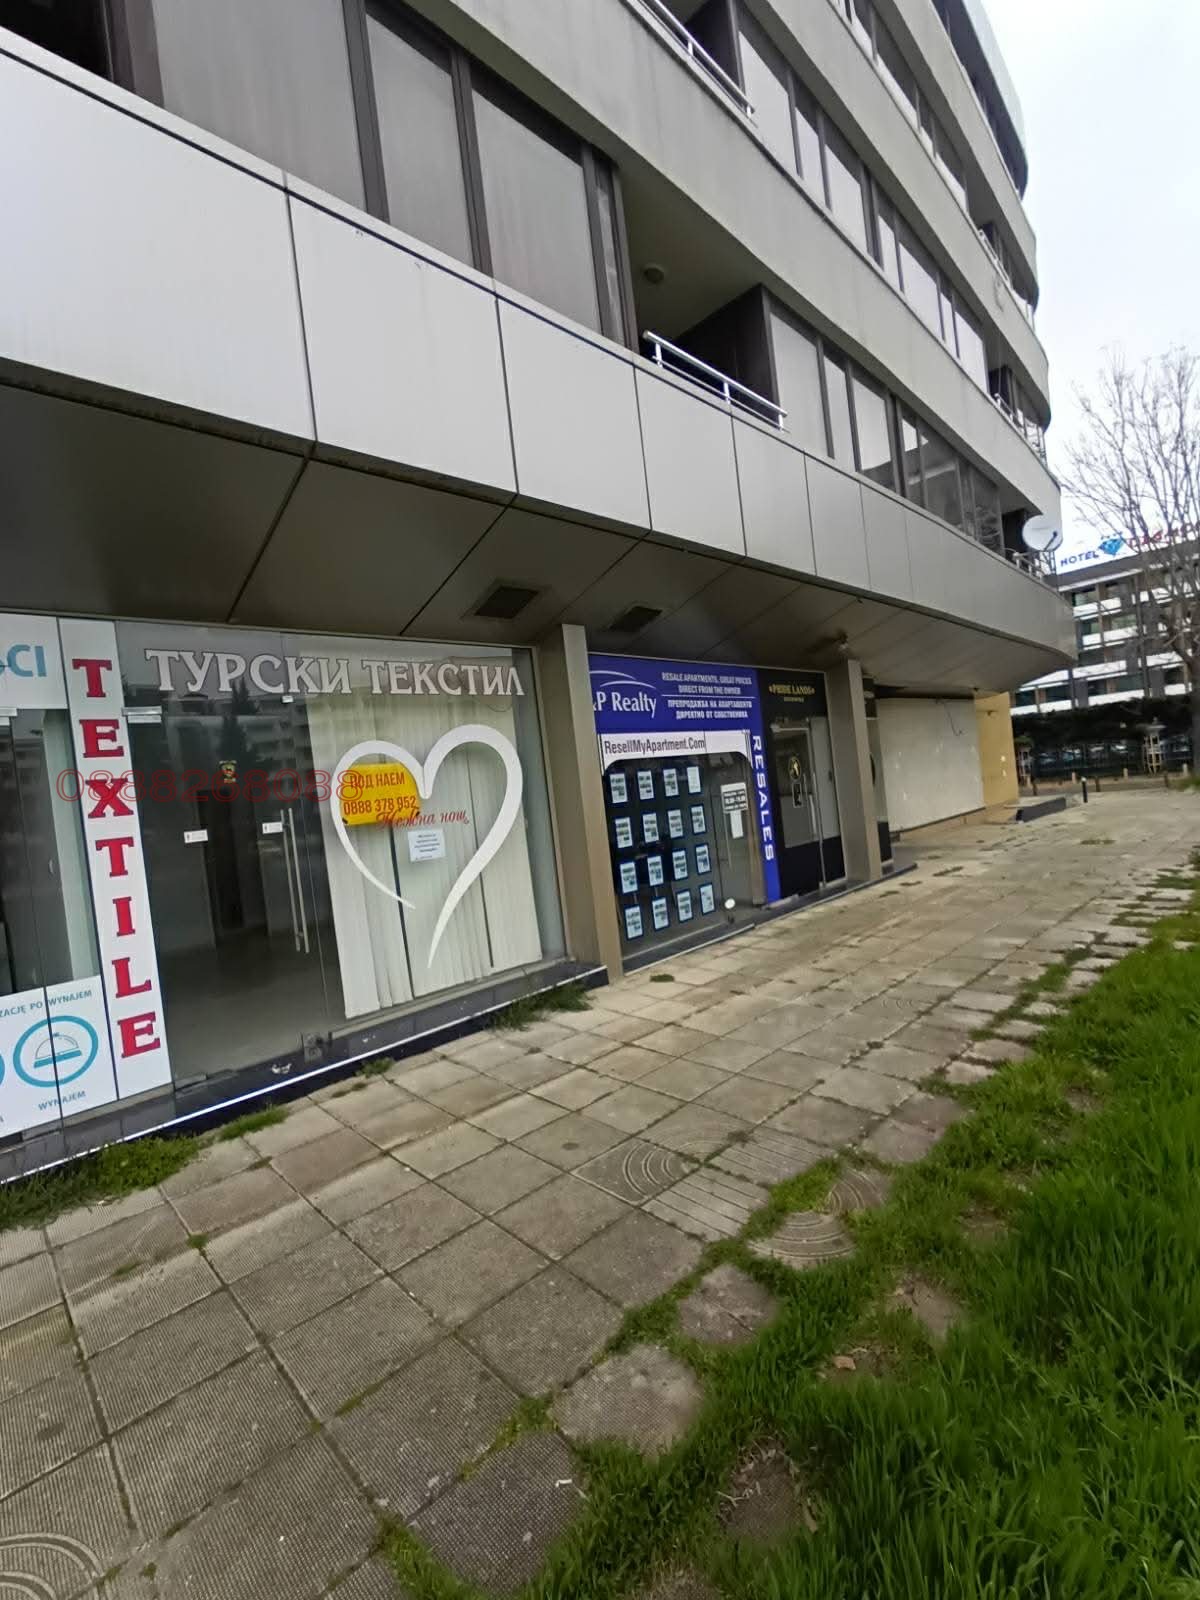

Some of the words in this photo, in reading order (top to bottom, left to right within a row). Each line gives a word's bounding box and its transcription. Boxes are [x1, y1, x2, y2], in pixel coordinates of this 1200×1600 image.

[1060, 550, 1099, 567] HOTEL
[144, 649, 352, 695] ТУРСКИ
[361, 659, 525, 696] ТЕКСТИЛ
[698, 686, 714, 694] FROM
[611, 691, 657, 719] Realty
[604, 737, 705, 755] ResellMyApartment.Com
[349, 773, 374, 789] ПОД
[376, 772, 405, 786] НАЕМ
[343, 800, 372, 816] 0888
[375, 798, 394, 812] 378
[397, 796, 416, 812] 952
[752, 735, 774, 861] RESALES
[440, 809, 470, 824] нощ
[72, 658, 161, 1058] TEXTILE
[30, 1001, 43, 1010] PO
[48, 989, 92, 1007] WYNAJEM
[38, 1090, 86, 1111] WYNAJEM
